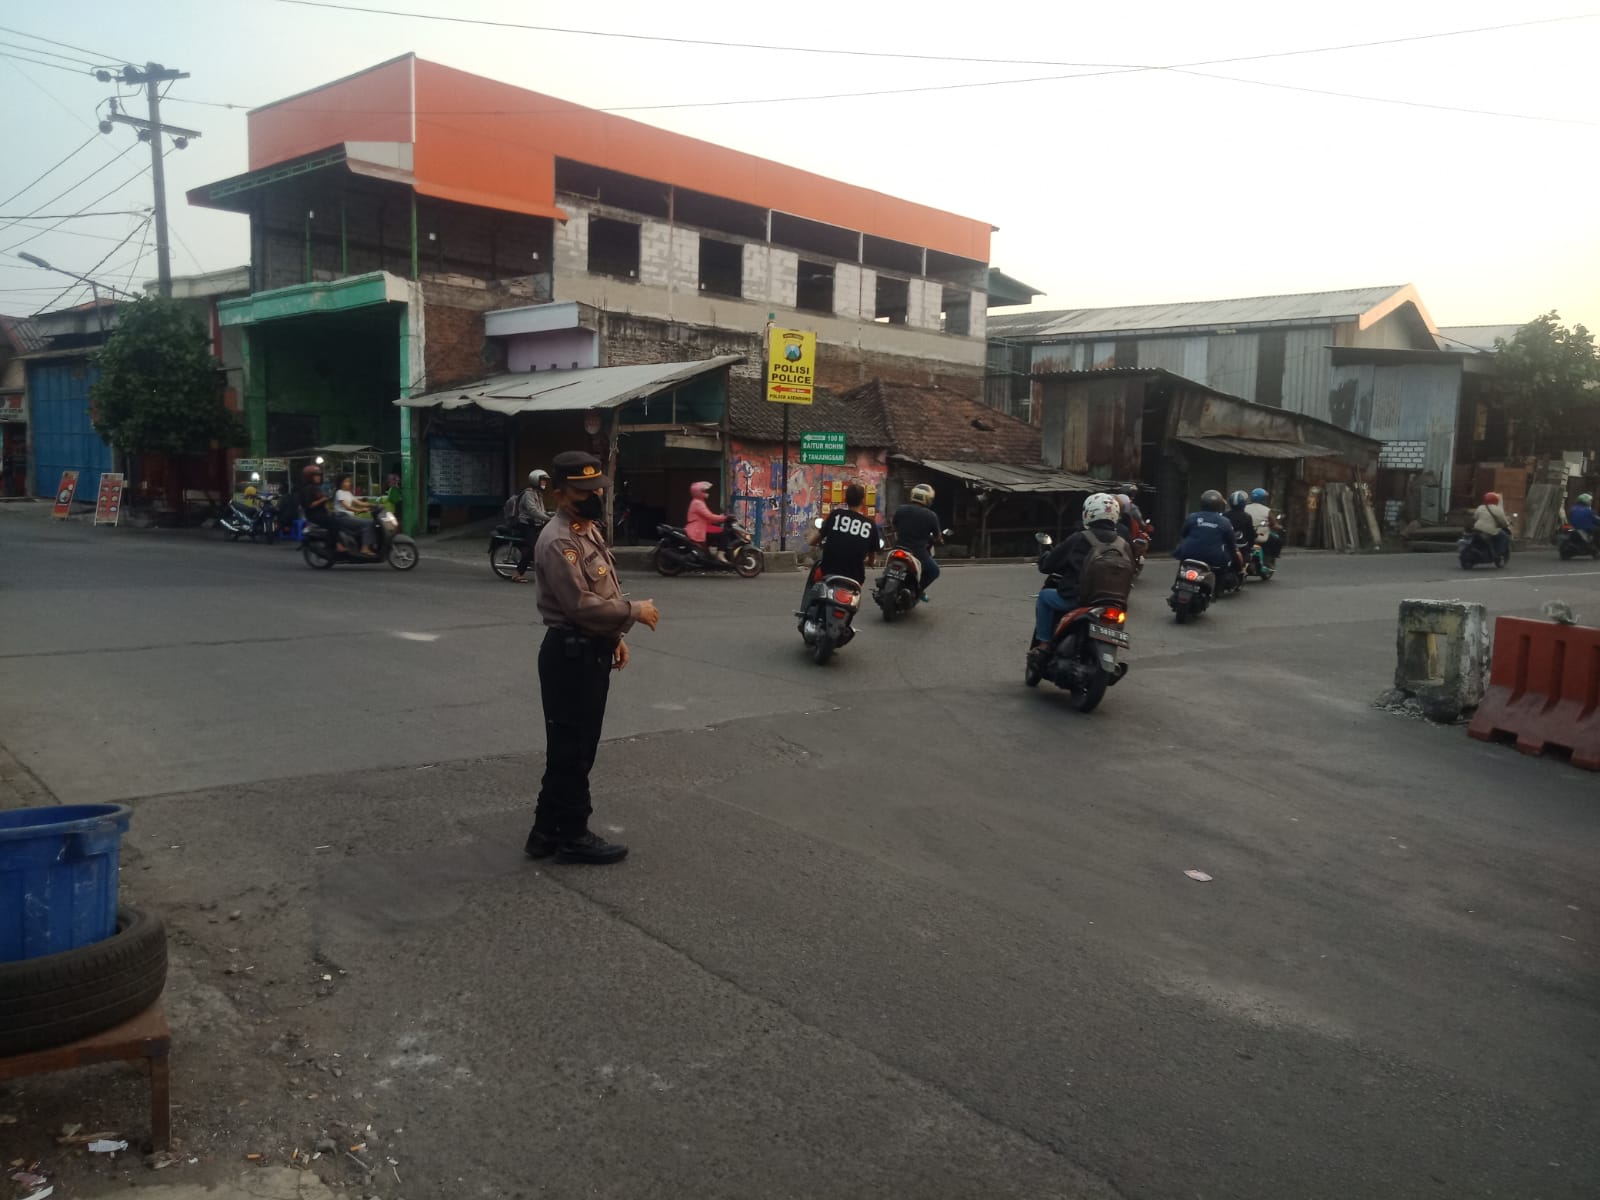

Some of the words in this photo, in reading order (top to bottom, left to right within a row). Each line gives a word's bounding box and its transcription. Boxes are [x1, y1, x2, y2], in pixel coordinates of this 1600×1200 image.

[774, 364, 809, 374] POLISI
[771, 373, 811, 384] POLICE
[832, 514, 872, 538] 1986
